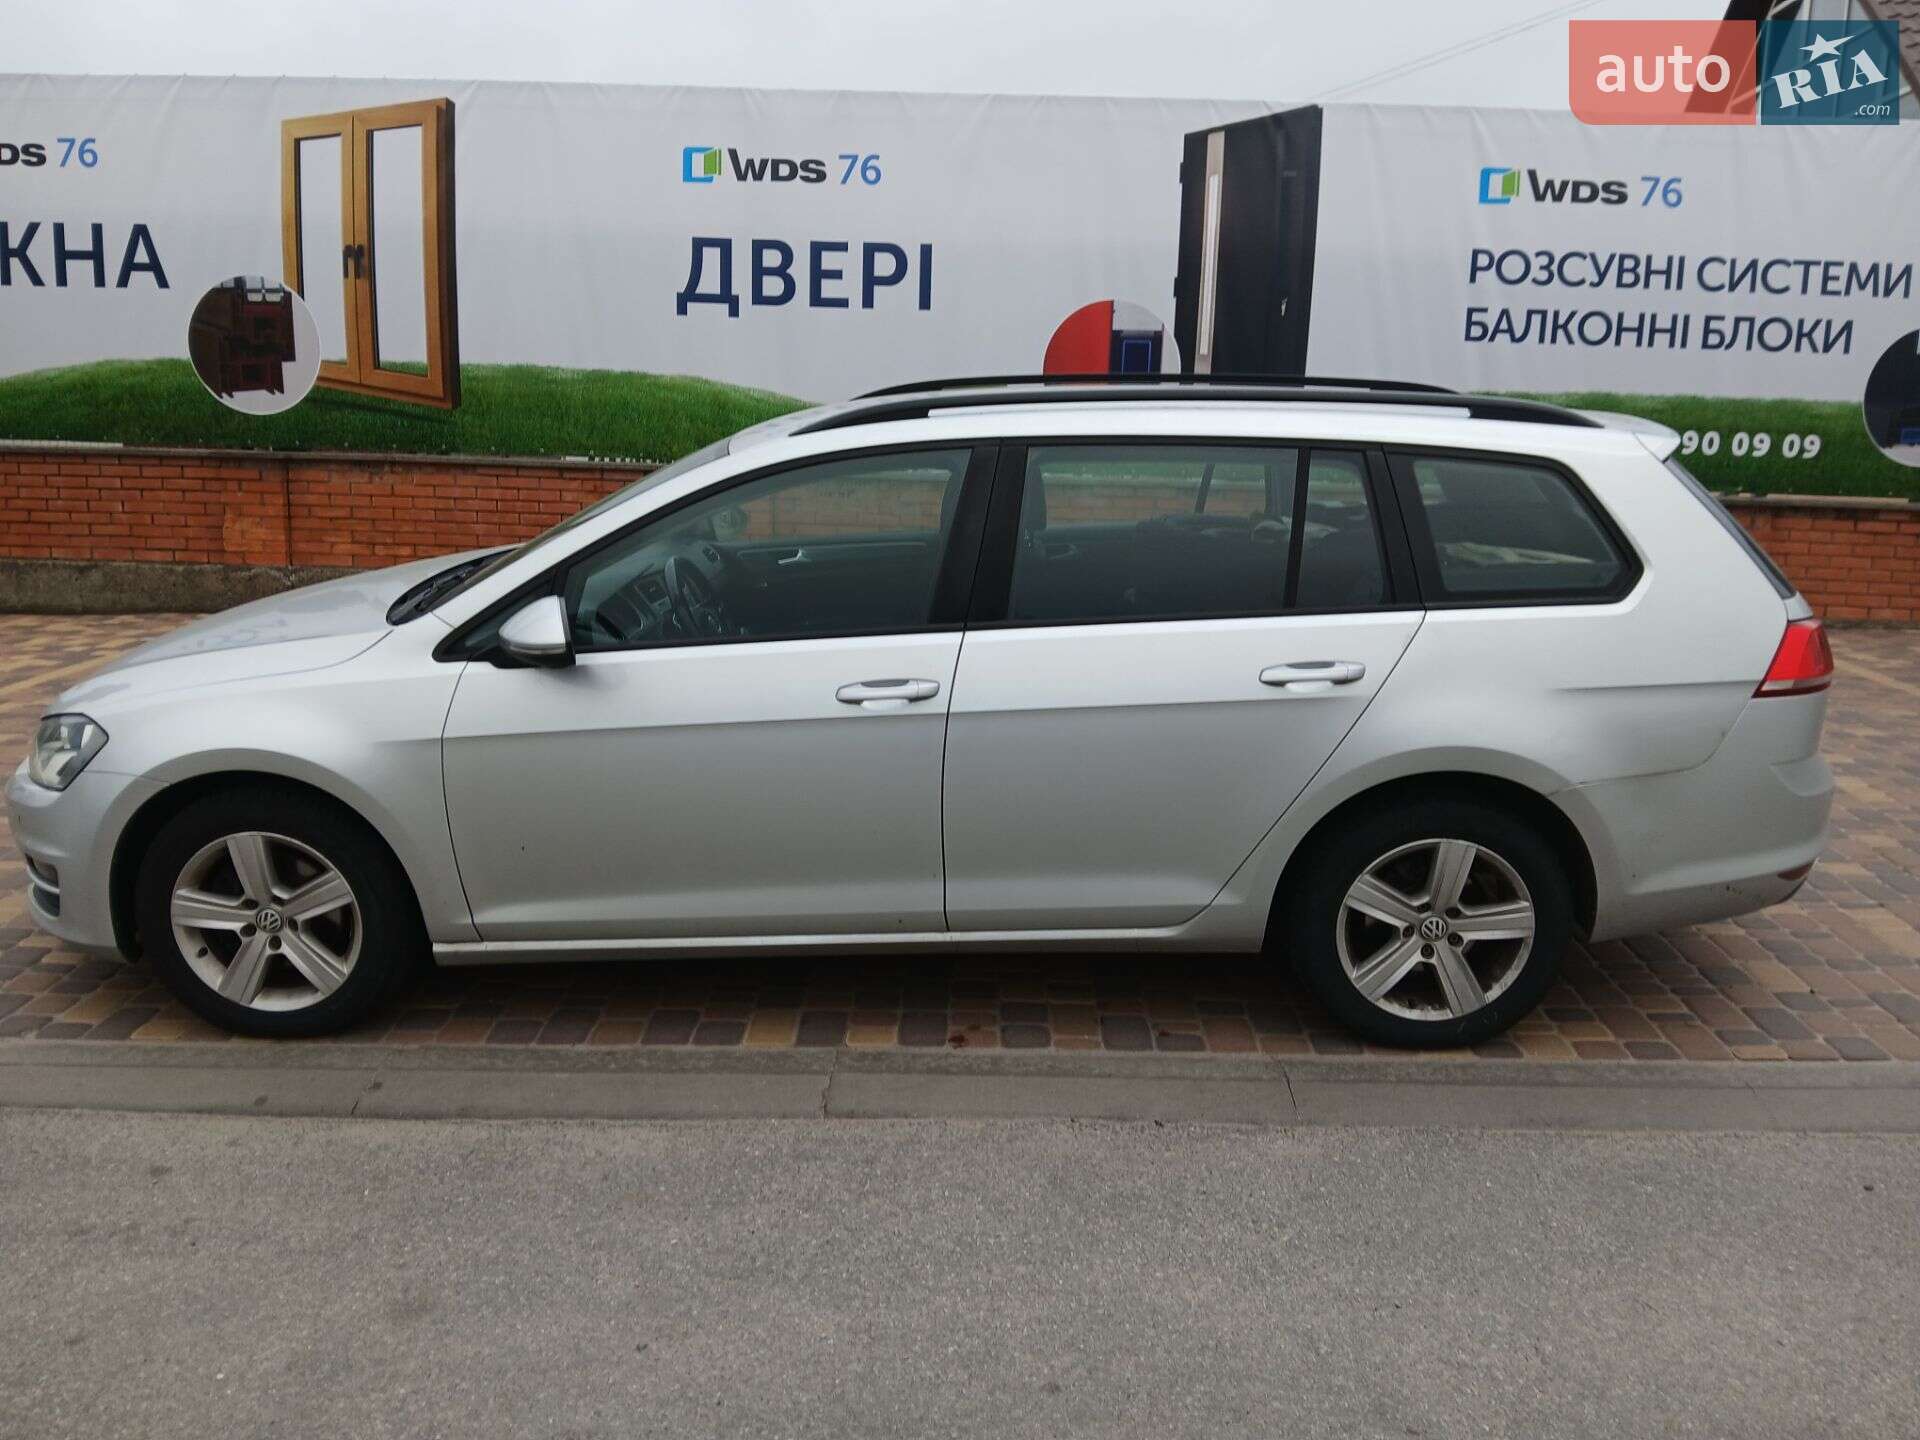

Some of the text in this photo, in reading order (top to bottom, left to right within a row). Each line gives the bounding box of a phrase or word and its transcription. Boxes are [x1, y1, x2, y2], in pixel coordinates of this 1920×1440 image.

[56, 137, 99, 169] 76
[727, 147, 882, 186] WDS 76
[1526, 168, 1683, 208] WDS 76
[0, 220, 171, 289] КНА
[1468, 247, 1914, 300] РОЗСУВНІ СИСТЕМИ
[676, 236, 934, 319] ДВЕРІ
[1463, 306, 1855, 356] БАЛКОННІ БЛОКИ
[1681, 429, 1822, 460] 90 09 09
